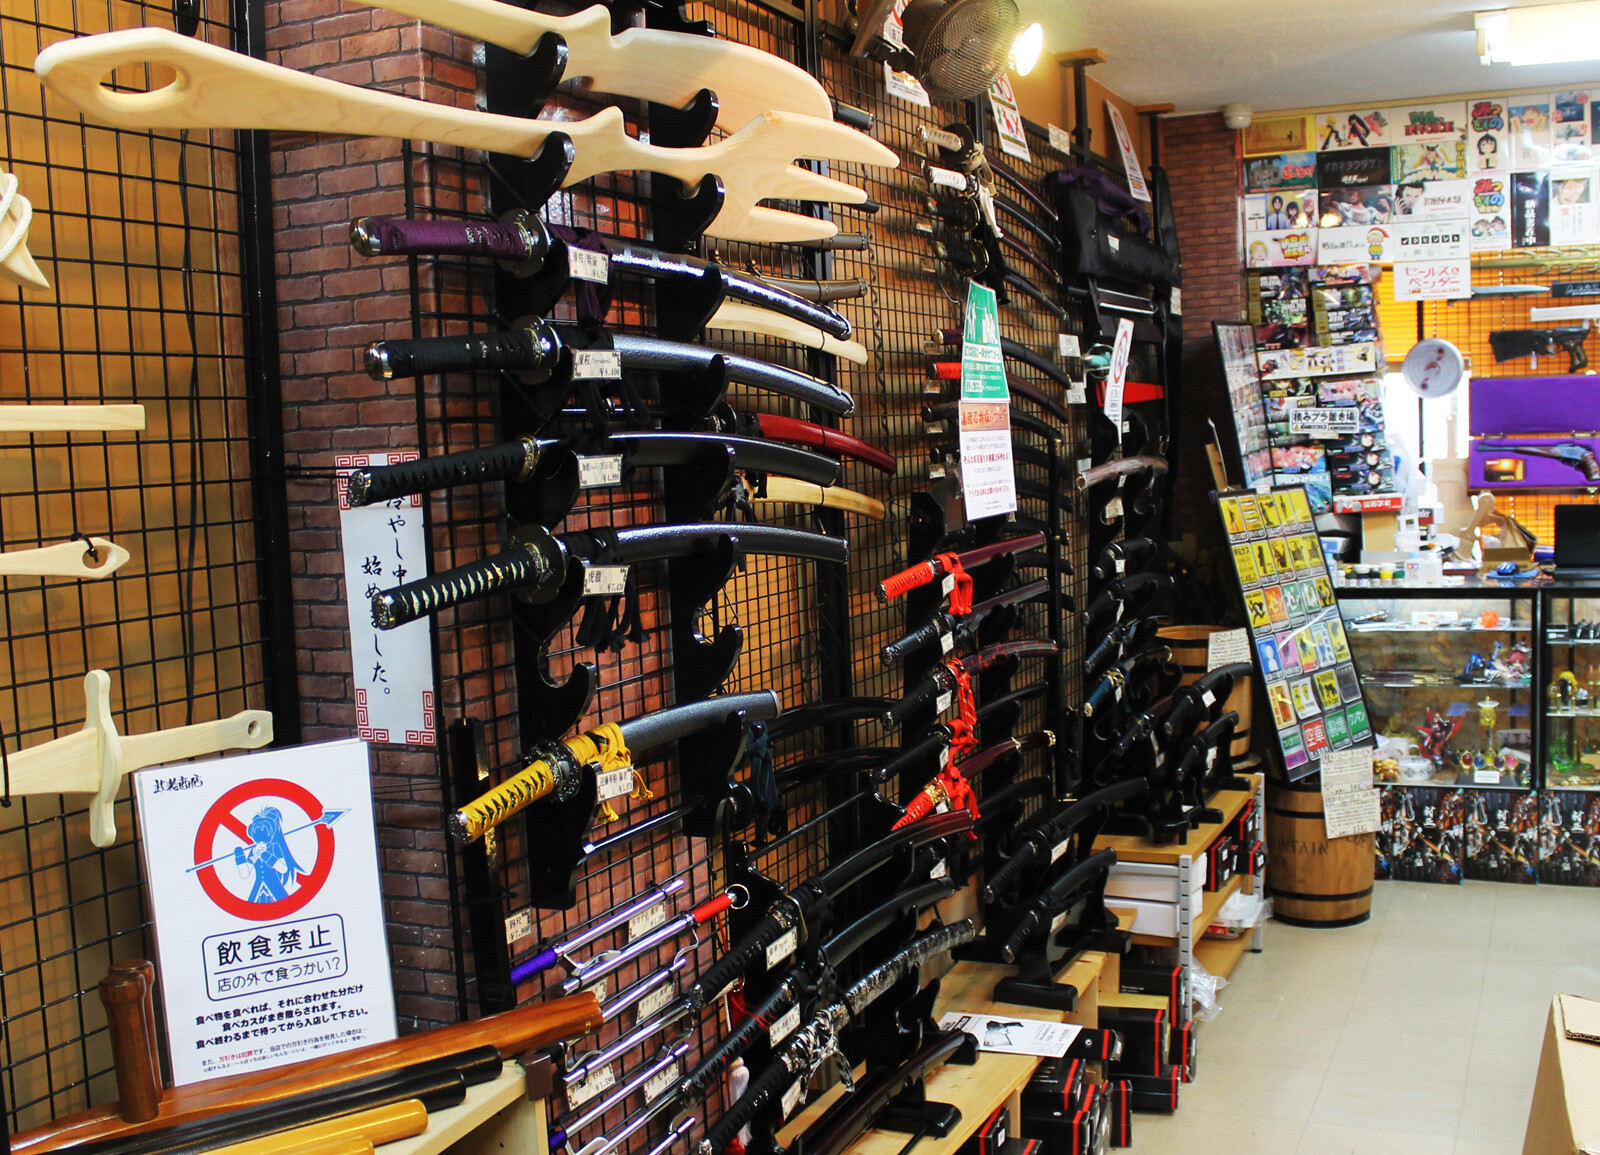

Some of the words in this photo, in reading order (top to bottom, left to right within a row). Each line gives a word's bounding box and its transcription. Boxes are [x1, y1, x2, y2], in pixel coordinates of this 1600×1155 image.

[1409, 277, 1460, 290] ベンダー
[1306, 724, 1325, 747] 空車
[217, 924, 332, 967] 飲食禁止
[217, 956, 341, 993] 店の外で食うかい？
[195, 984, 364, 1026] 食べ物を食べれば、それに合わせた分だけ
[221, 1003, 343, 1032] 食べカスがまき散らされます。
[196, 1007, 370, 1049] 食べ終わるまで待ってから入店して下さい。
